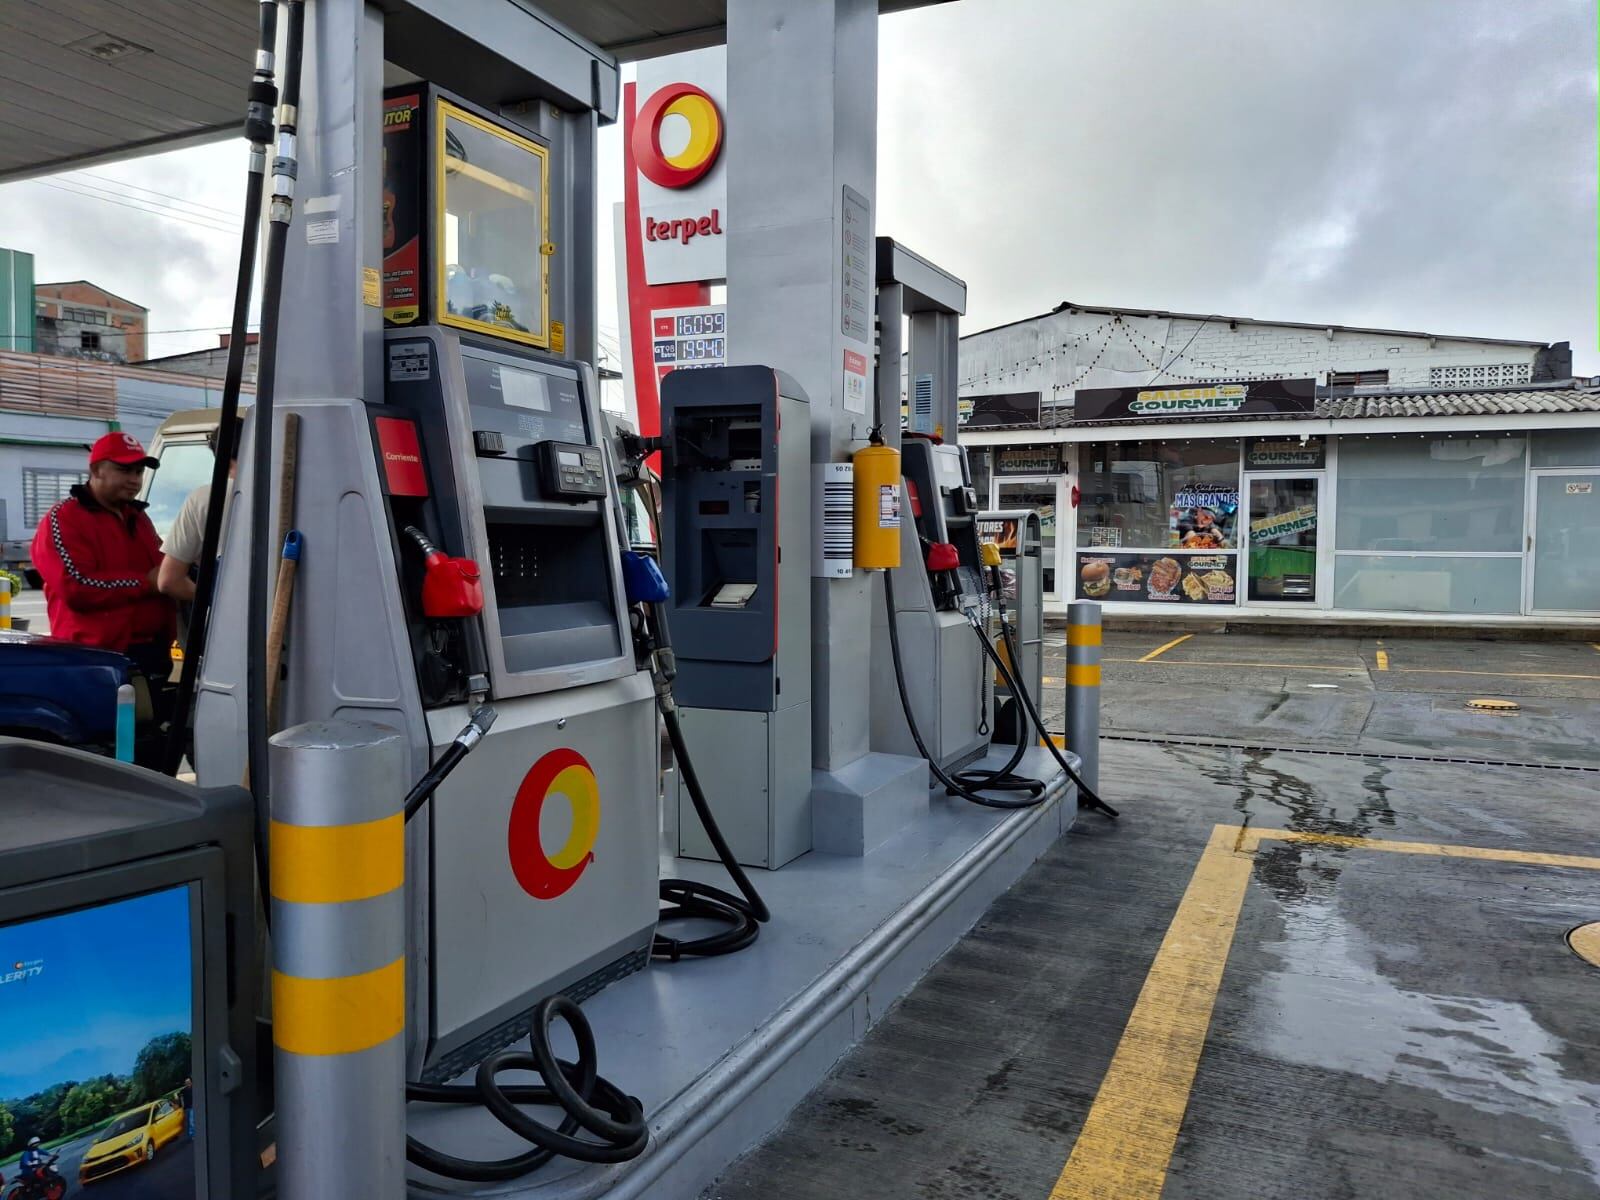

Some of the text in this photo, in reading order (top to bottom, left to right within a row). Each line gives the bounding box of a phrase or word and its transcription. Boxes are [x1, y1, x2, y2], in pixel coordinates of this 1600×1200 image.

[646, 208, 722, 246] terpel
[1129, 397, 1244, 411] GOURMET
[385, 451, 419, 463] Corriente
[1248, 451, 1319, 461] GOURMET
[1250, 515, 1317, 539] GOURMET
